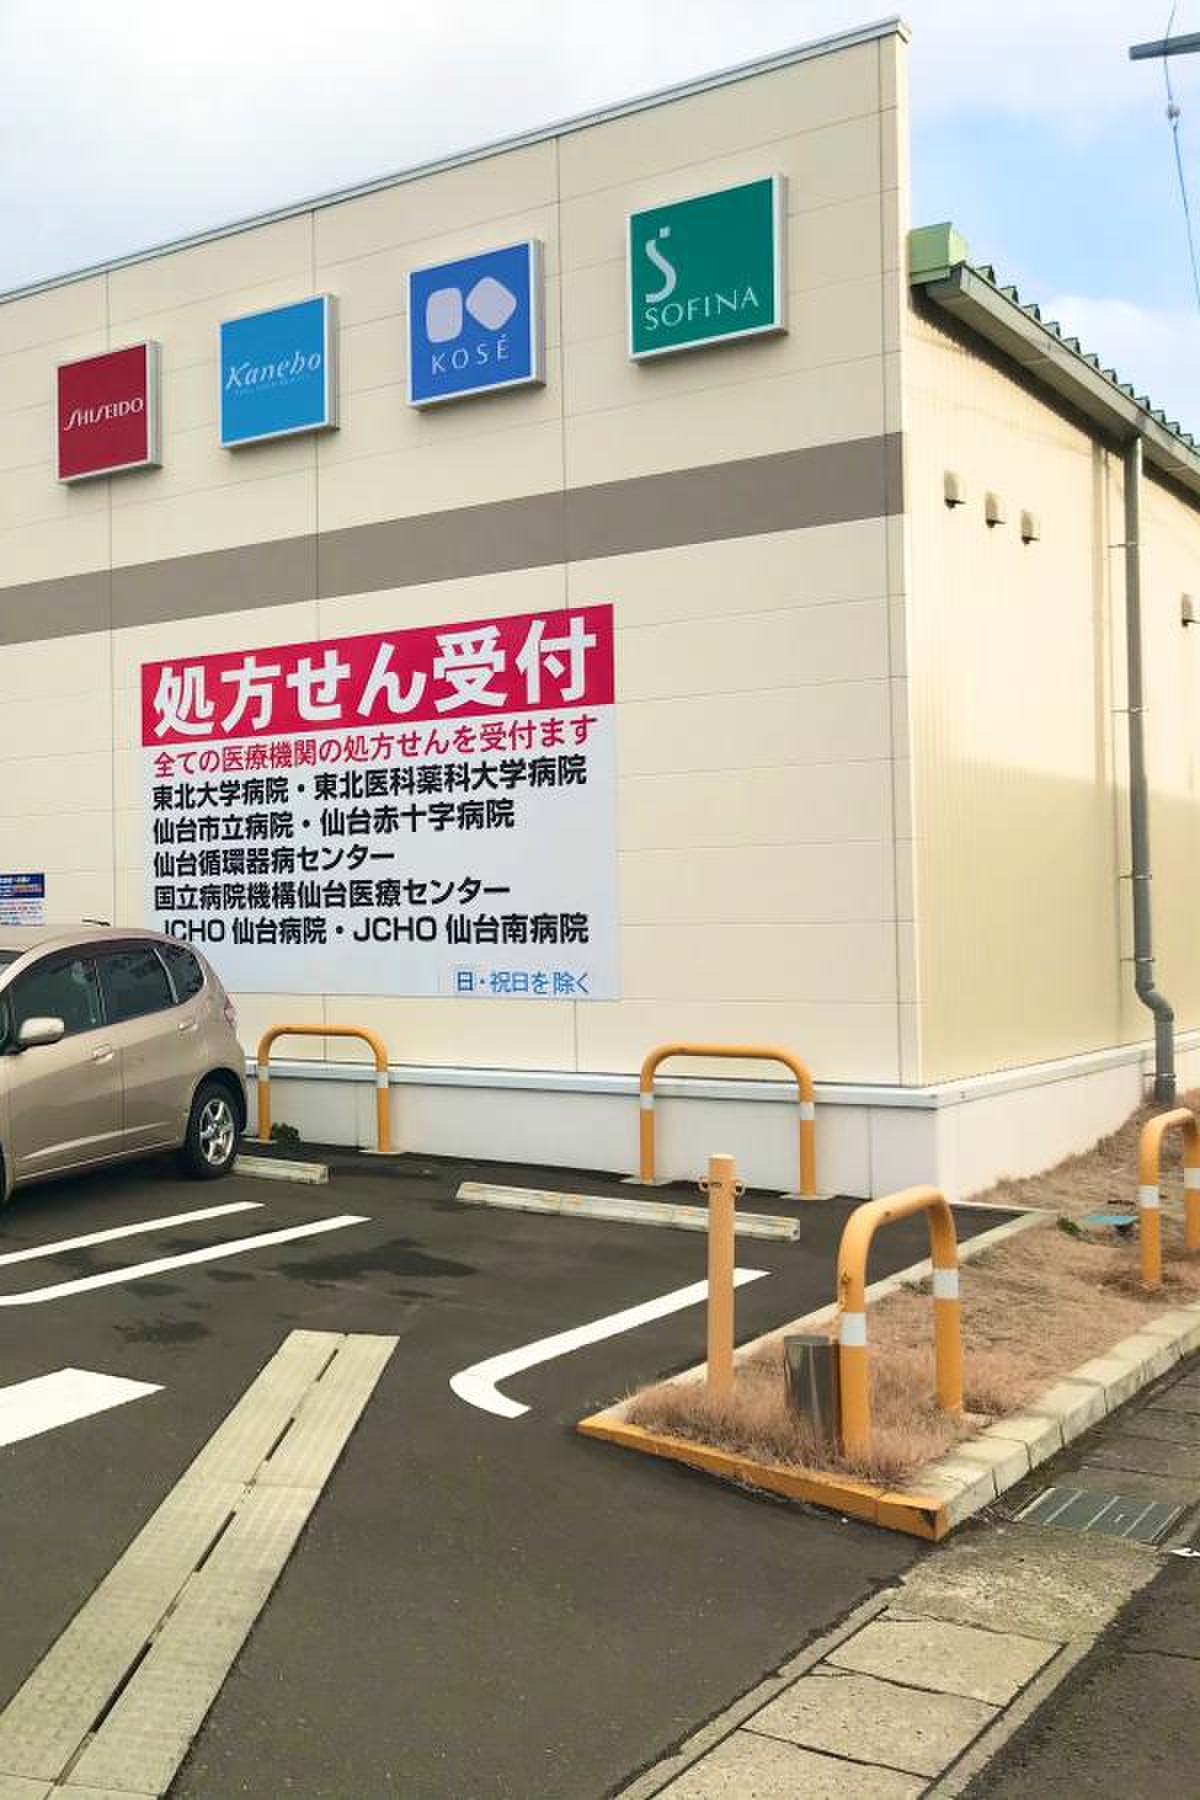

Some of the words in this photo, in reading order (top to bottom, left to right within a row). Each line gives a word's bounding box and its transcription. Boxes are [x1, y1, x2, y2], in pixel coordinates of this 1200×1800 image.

[644, 287, 760, 332] SOFINA
[224, 350, 321, 391] Kanebo
[431, 333, 509, 375] KOSÉ
[63, 397, 144, 431] SHISEIDO
[153, 616, 597, 737] 処方せん受付
[153, 713, 598, 779] 全ての医療機関の処方せんを受付ます
[152, 753, 588, 811] 東北大学病院・東北医科薬科大学病院
[152, 797, 516, 845] 仙台市立病院・仙台赤十字病院
[152, 843, 395, 878] 仙台循環器病センター
[153, 875, 511, 911] 国立病院機構仙台医療センター
[456, 970, 590, 995] 日・祝日を除く
